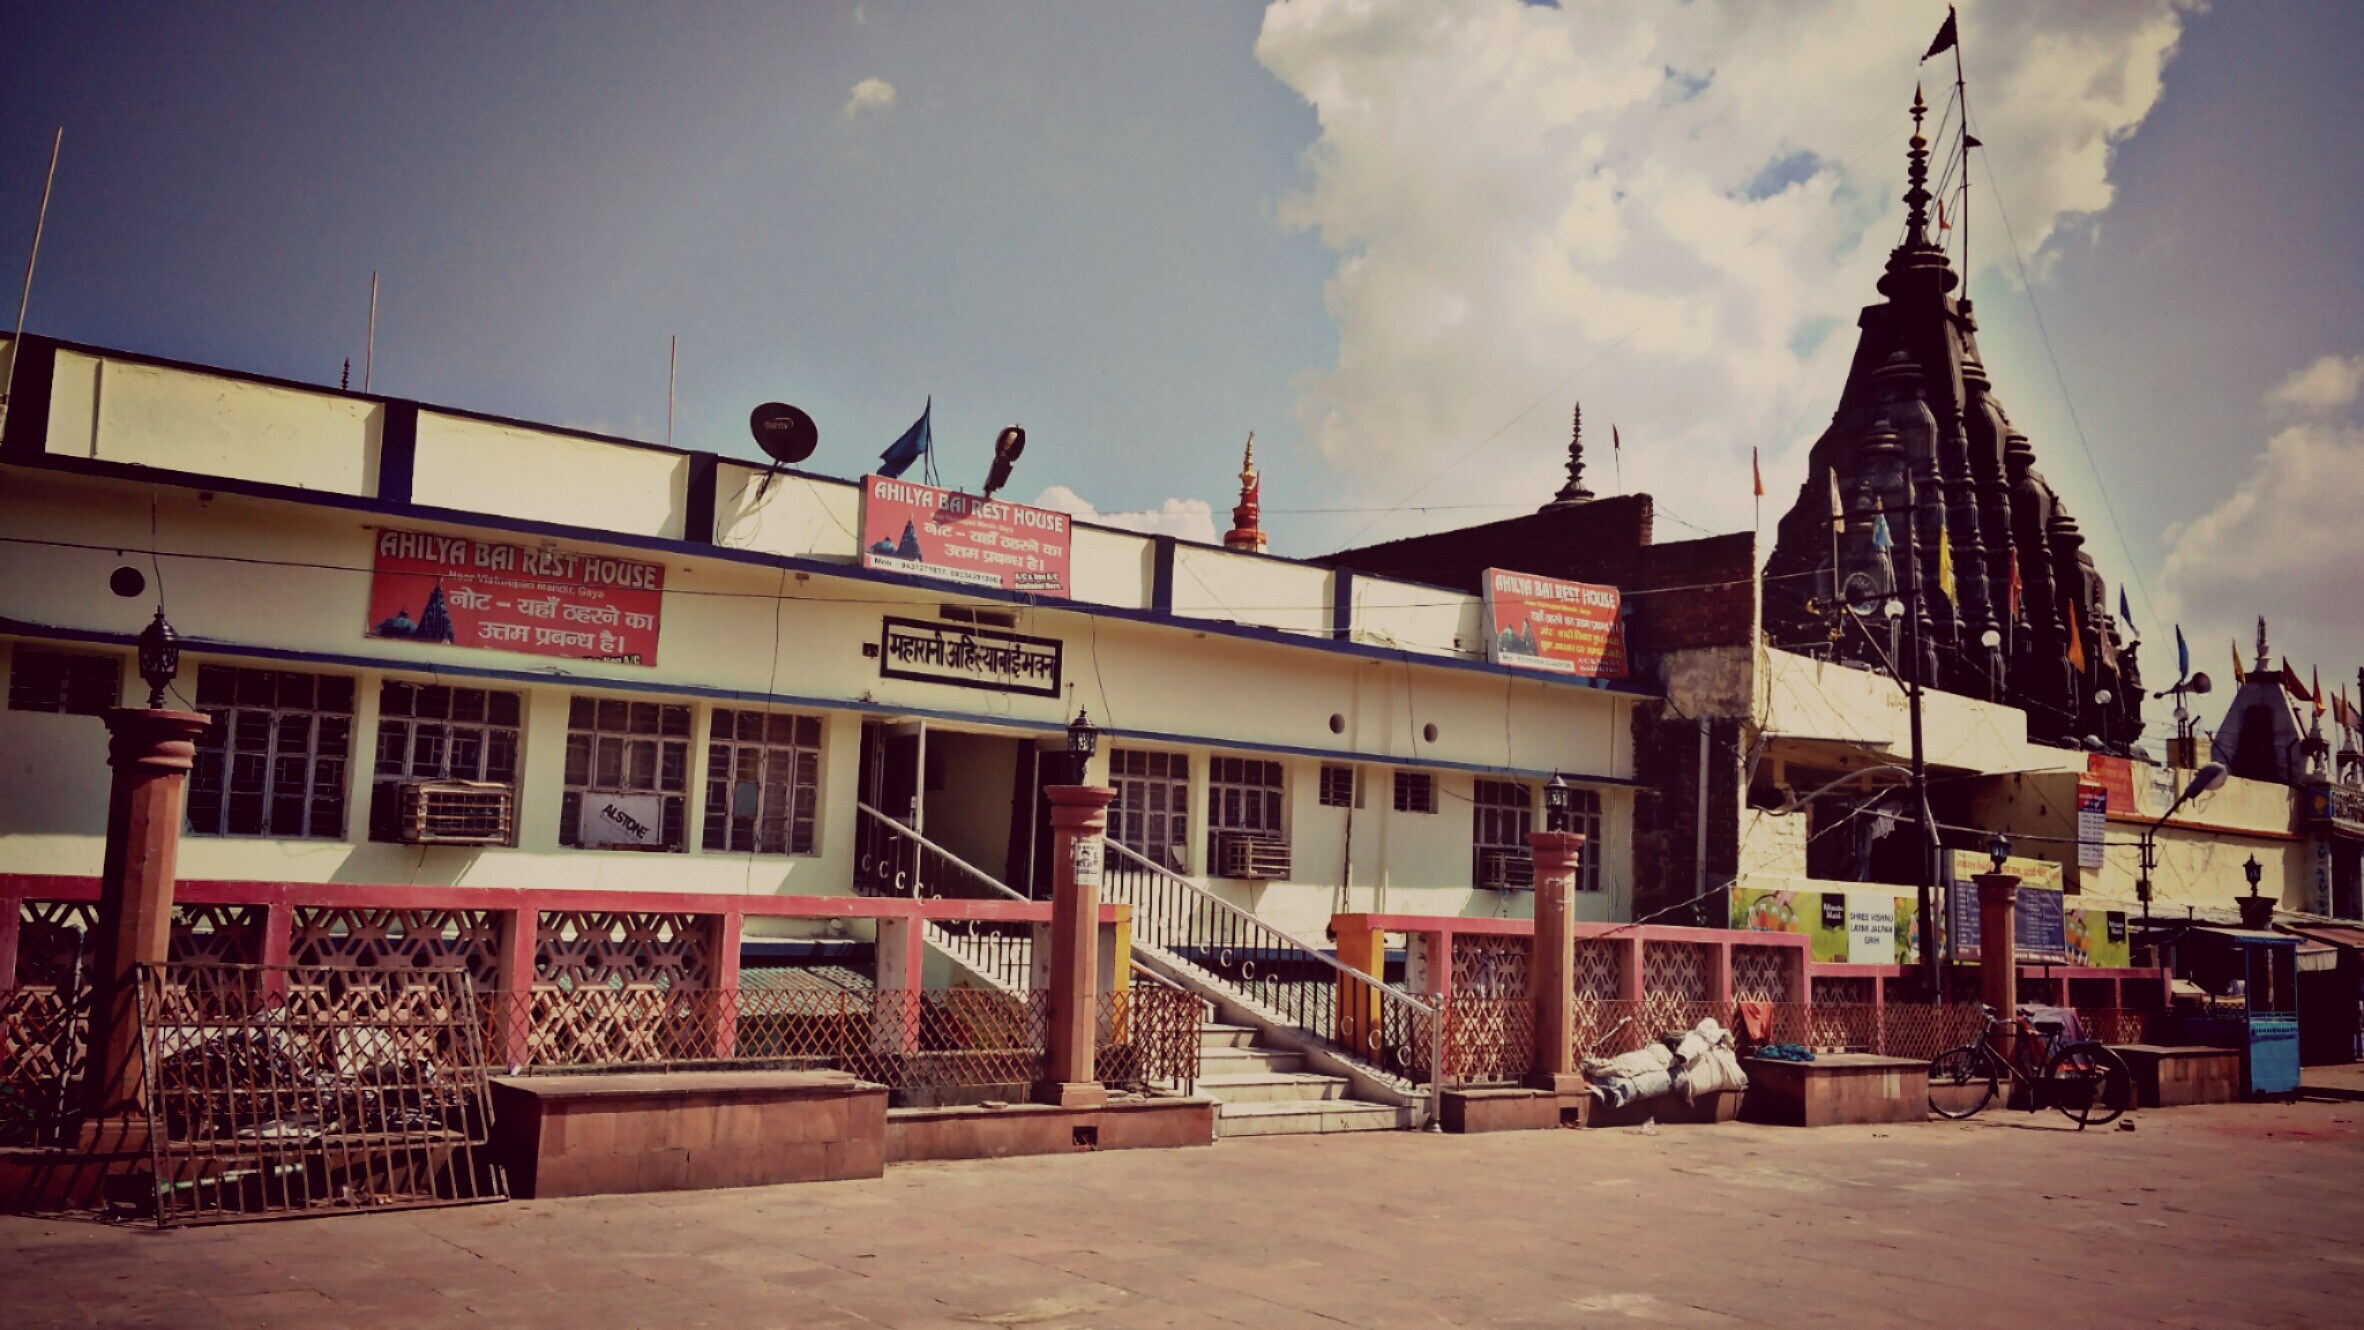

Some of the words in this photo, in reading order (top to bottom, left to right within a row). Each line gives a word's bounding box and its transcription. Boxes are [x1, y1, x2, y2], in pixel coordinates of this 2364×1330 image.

[875, 482, 934, 507] AHILYA
[938, 492, 967, 514] BAI
[971, 499, 1010, 522] REST
[1013, 508, 1064, 533] HOUSE
[380, 531, 467, 566] AHILYA
[474, 542, 516, 571] BAI
[522, 547, 579, 579] REST
[583, 558, 657, 590] HOUSE
[449, 586, 493, 611] नोट
[516, 595, 561, 619] यहाँ
[562, 603, 621, 627] ठहरने
[624, 611, 655, 631] का
[1495, 574, 1533, 596] AHILYA
[1534, 580, 1553, 599] BAI
[1554, 583, 1580, 604] REST
[1582, 588, 1616, 610] HOUSE
[477, 620, 531, 643] उत्तम
[534, 626, 597, 650] प्रबन्ध
[599, 630, 625, 653] है।
[889, 630, 946, 667] महारानी
[601, 803, 651, 840] ALSTONE
[1850, 912, 1870, 921] SHREE
